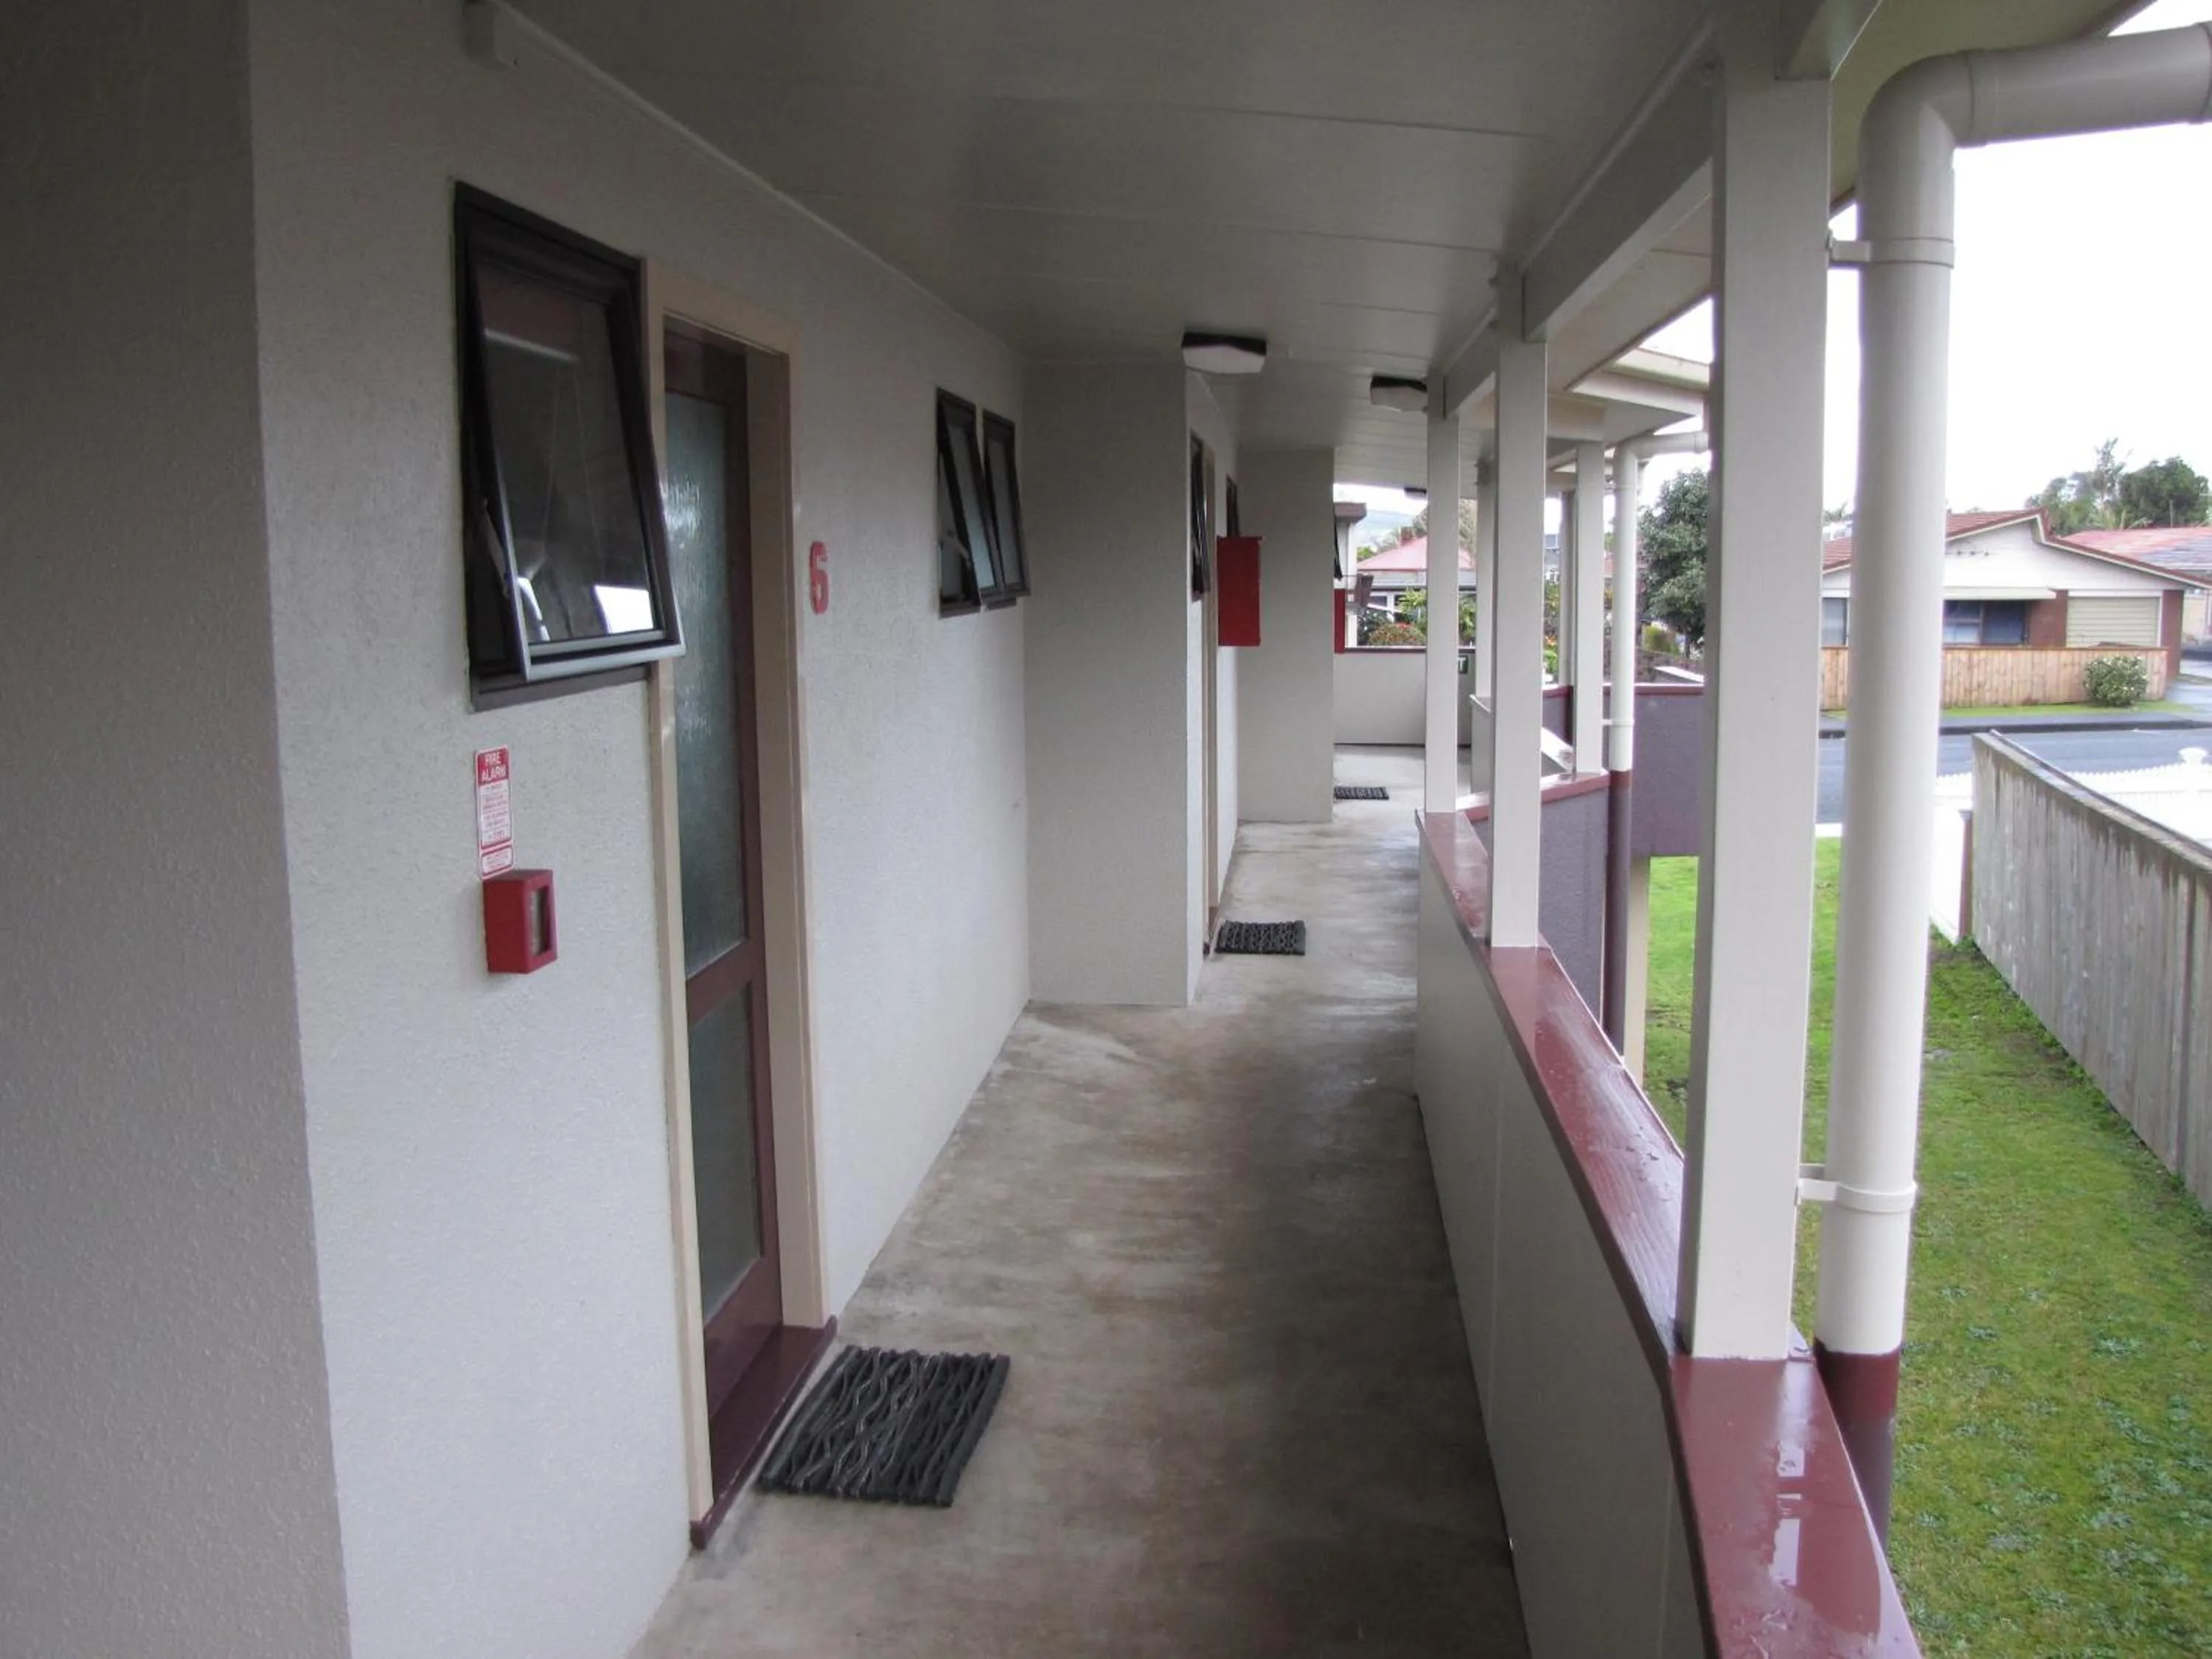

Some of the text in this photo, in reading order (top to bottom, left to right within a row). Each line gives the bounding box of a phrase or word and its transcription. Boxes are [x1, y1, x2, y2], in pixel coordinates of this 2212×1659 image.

[810, 541, 829, 615] 6
[484, 751, 501, 767] FIRE
[481, 765, 507, 782] ALARM
